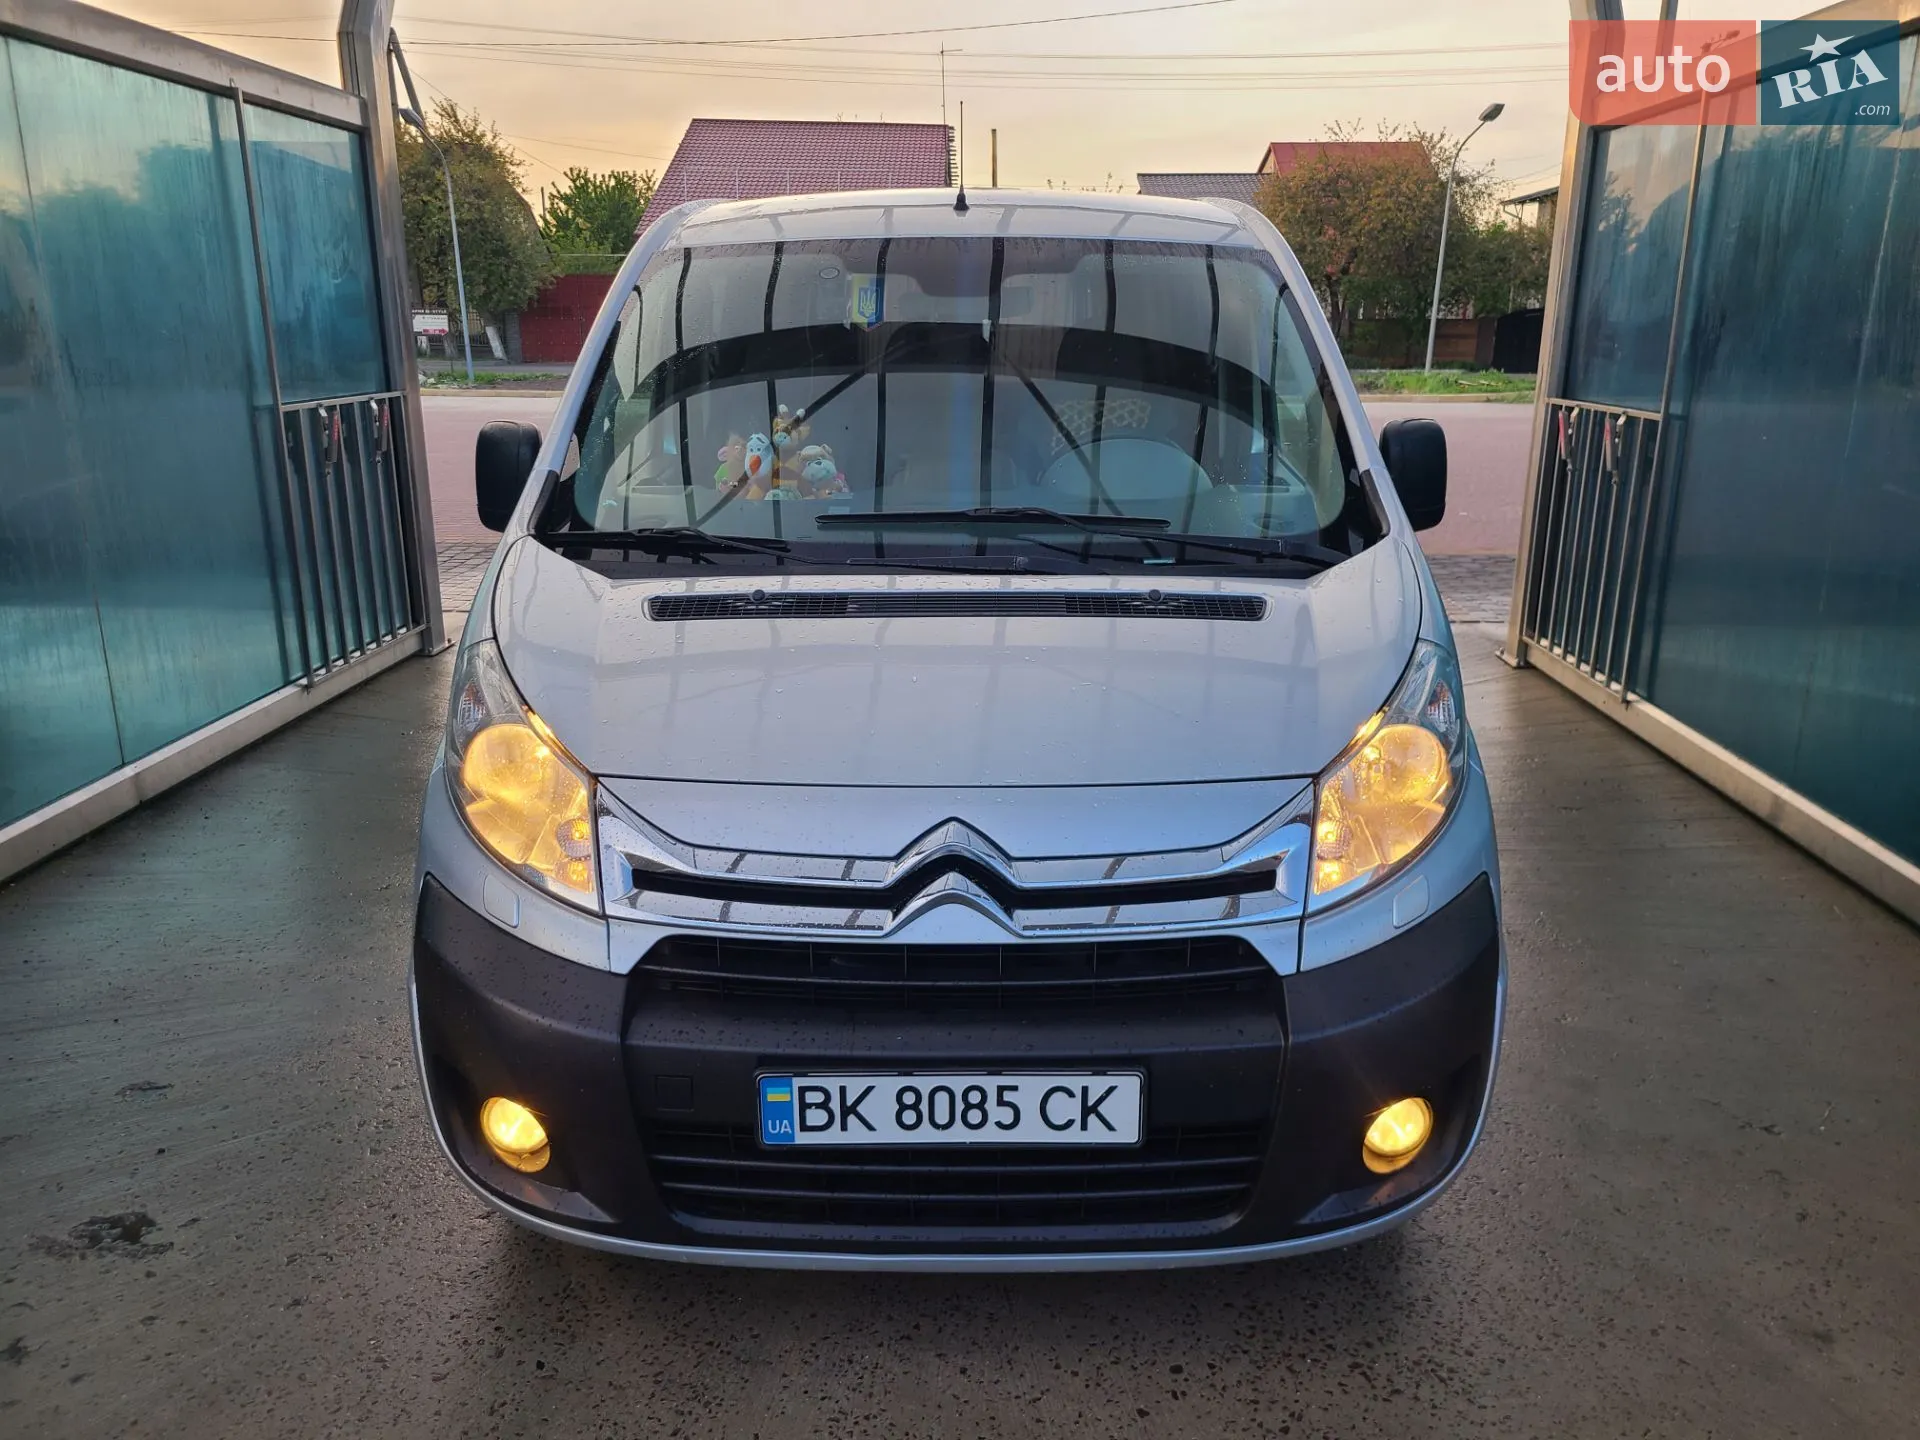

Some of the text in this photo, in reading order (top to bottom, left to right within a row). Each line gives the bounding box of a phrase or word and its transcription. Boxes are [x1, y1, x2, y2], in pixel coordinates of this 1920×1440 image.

[797, 1084, 1118, 1132] BK 8085 CK
[768, 1119, 792, 1134] UA
